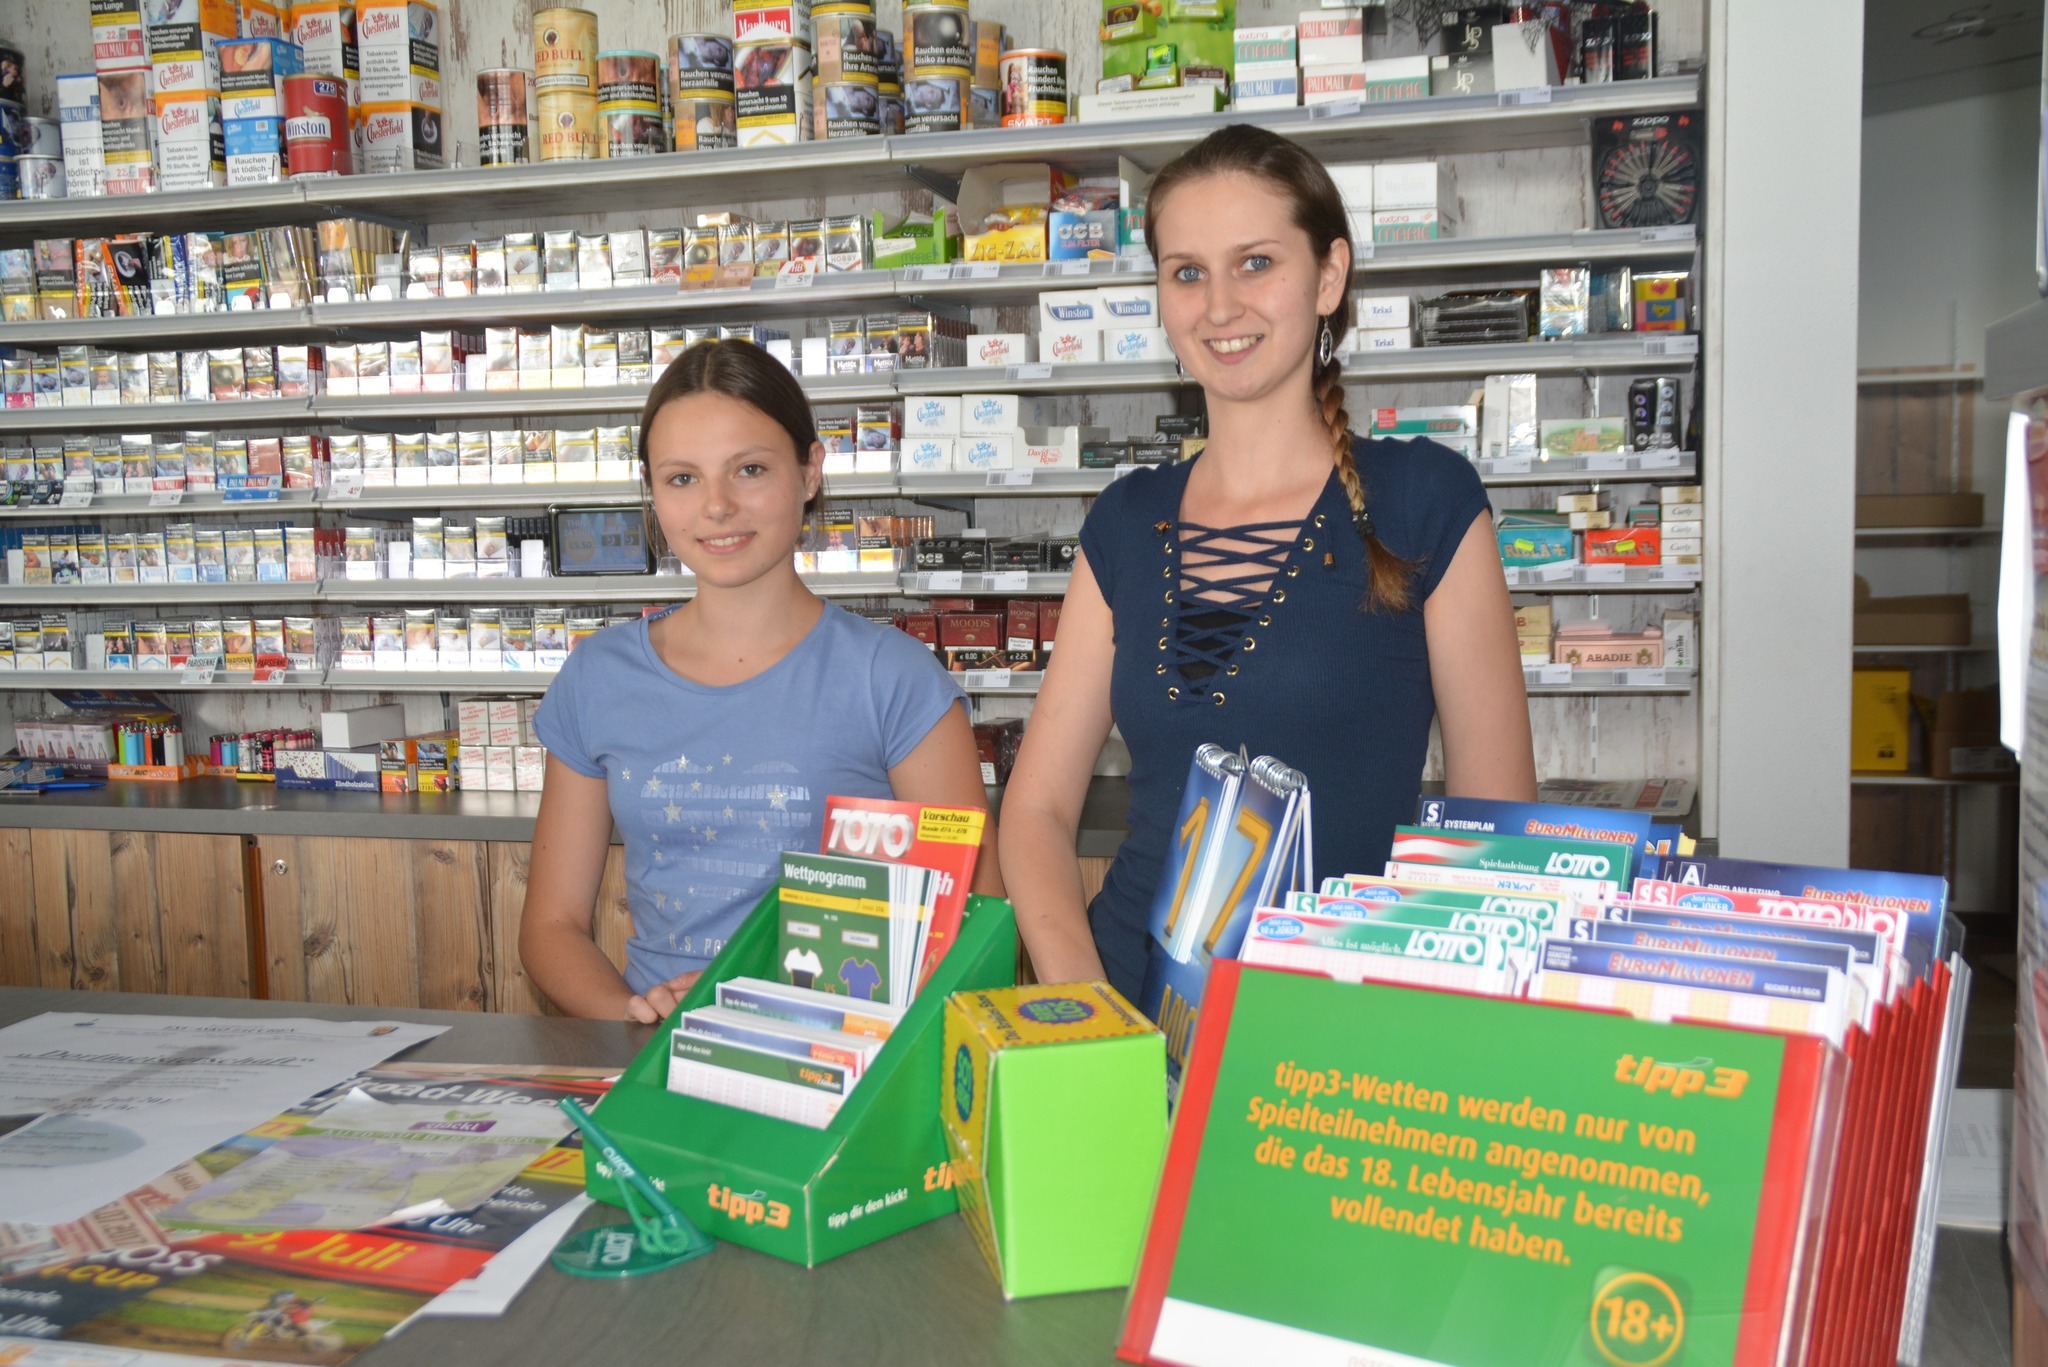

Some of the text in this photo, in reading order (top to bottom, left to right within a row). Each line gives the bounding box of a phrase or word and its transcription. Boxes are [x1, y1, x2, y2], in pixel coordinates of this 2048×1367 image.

[104, 2, 124, 10] Lunge
[298, 18, 332, 46] Chesterfield
[362, 14, 400, 40] Chesterfield
[738, 11, 787, 38] Marlboro
[1303, 21, 1339, 37] PALL MALL
[1238, 31, 1269, 40] extra
[96, 41, 125, 58] PALL MALL
[552, 48, 585, 61] BULL
[914, 46, 945, 55] Rauchen
[1238, 42, 1291, 60] MARIE
[843, 62, 859, 71] Ihre
[914, 55, 936, 64] Risiko
[159, 65, 194, 89] Chesterfield
[680, 69, 708, 79] Rauchen
[1028, 65, 1058, 75] Rauchen
[319, 82, 336, 92] 275
[680, 79, 719, 88] Herzanfälle
[1028, 74, 1056, 84] mindert
[1308, 76, 1344, 92] PALL MALL
[737, 90, 759, 99] Rauchen
[1238, 80, 1274, 97] PALL MALL
[1368, 81, 1425, 101] MARIE
[234, 99, 261, 118] Chesterfield
[738, 96, 766, 106] verursacht
[780, 95, 787, 103] 10
[738, 103, 787, 114] Lungenkarzinomen
[162, 109, 199, 135] Chesterfield
[828, 120, 858, 129] Rauchen
[921, 114, 958, 124] verursacht
[1007, 118, 1052, 128] SMART
[286, 120, 326, 137] Winston
[367, 118, 403, 144] Chesterfield
[542, 131, 564, 145] RED
[65, 146, 102, 156] Rauchen
[79, 157, 90, 166] ist
[235, 156, 267, 165] Rauchen
[231, 164, 266, 174] ist tödlich
[67, 179, 90, 188] hören
[235, 174, 256, 183] hören
[1378, 213, 1410, 224] extra
[1058, 223, 1103, 240] OCB
[1378, 224, 1432, 242] MARIE
[970, 240, 1041, 261] ZIG-ZAG
[1077, 239, 1101, 247] FILTER
[792, 261, 803, 272] HB
[831, 254, 857, 263] HOBBY
[1058, 306, 1090, 319] Winston
[1116, 302, 1147, 315] Winston
[1371, 305, 1393, 315] Trixi
[980, 341, 1009, 361] Chesterfield
[1052, 340, 1082, 358] Chesterfield
[1117, 338, 1148, 357] Chesterfield
[1374, 338, 1395, 348] Trixi
[916, 406, 946, 423] Chesterfield
[973, 403, 1003, 421] Chesterfield
[913, 445, 942, 464] Chesterfield
[968, 444, 998, 464] Chesterfield
[1027, 448, 1048, 457] David
[1040, 456, 1058, 464] Ross
[1671, 506, 1694, 517] Curly
[1670, 525, 1693, 535] Curly
[1669, 542, 1693, 552] Curly
[916, 553, 944, 563] OCB
[1009, 609, 1036, 617] MOODS
[950, 618, 991, 628] MOODS
[187, 657, 217, 667] PARISIENNE
[257, 657, 288, 667] PARISIENNE
[1586, 652, 1632, 663] ABADIE
[334, 780, 375, 789] Zündholzaktion
[923, 811, 970, 823] Vorschau
[1427, 801, 1440, 822] S
[827, 808, 914, 859] TOTO
[1443, 819, 1495, 832] SYSTEMPLAN
[1478, 851, 1610, 878] Spielanleitung LOTTO
[783, 862, 867, 890] Wettprogramm
[1682, 864, 1701, 886] A
[1654, 885, 1668, 906] S
[1479, 896, 1555, 925] LOTTO
[1757, 899, 1842, 926] TOTO
[1301, 896, 1527, 944] S LOTTO
[1574, 919, 1589, 940] S
[668, 933, 697, 954] U.S.
[1260, 925, 1484, 964] 10 JOKER LOTTO
[1320, 936, 1404, 955] Alles ist möglich.
[800, 1066, 833, 1082] tipp3
[1615, 1054, 1749, 1099] tipp3
[1275, 1060, 1697, 1156] tipp3-Wetten werden nur von
[1246, 1096, 1711, 1208] Spielteilnehmern angenommen,
[1254, 1135, 1684, 1243] die das 18. Lebensjahr bereits
[707, 1183, 791, 1229] tipp3
[828, 1188, 908, 1229] tipp dir den kick!
[430, 1214, 486, 1236] Uhr
[1330, 1194, 1572, 1267] vollendet haben.
[290, 1232, 417, 1271] Juli
[1601, 1295, 1676, 1344] 18+
